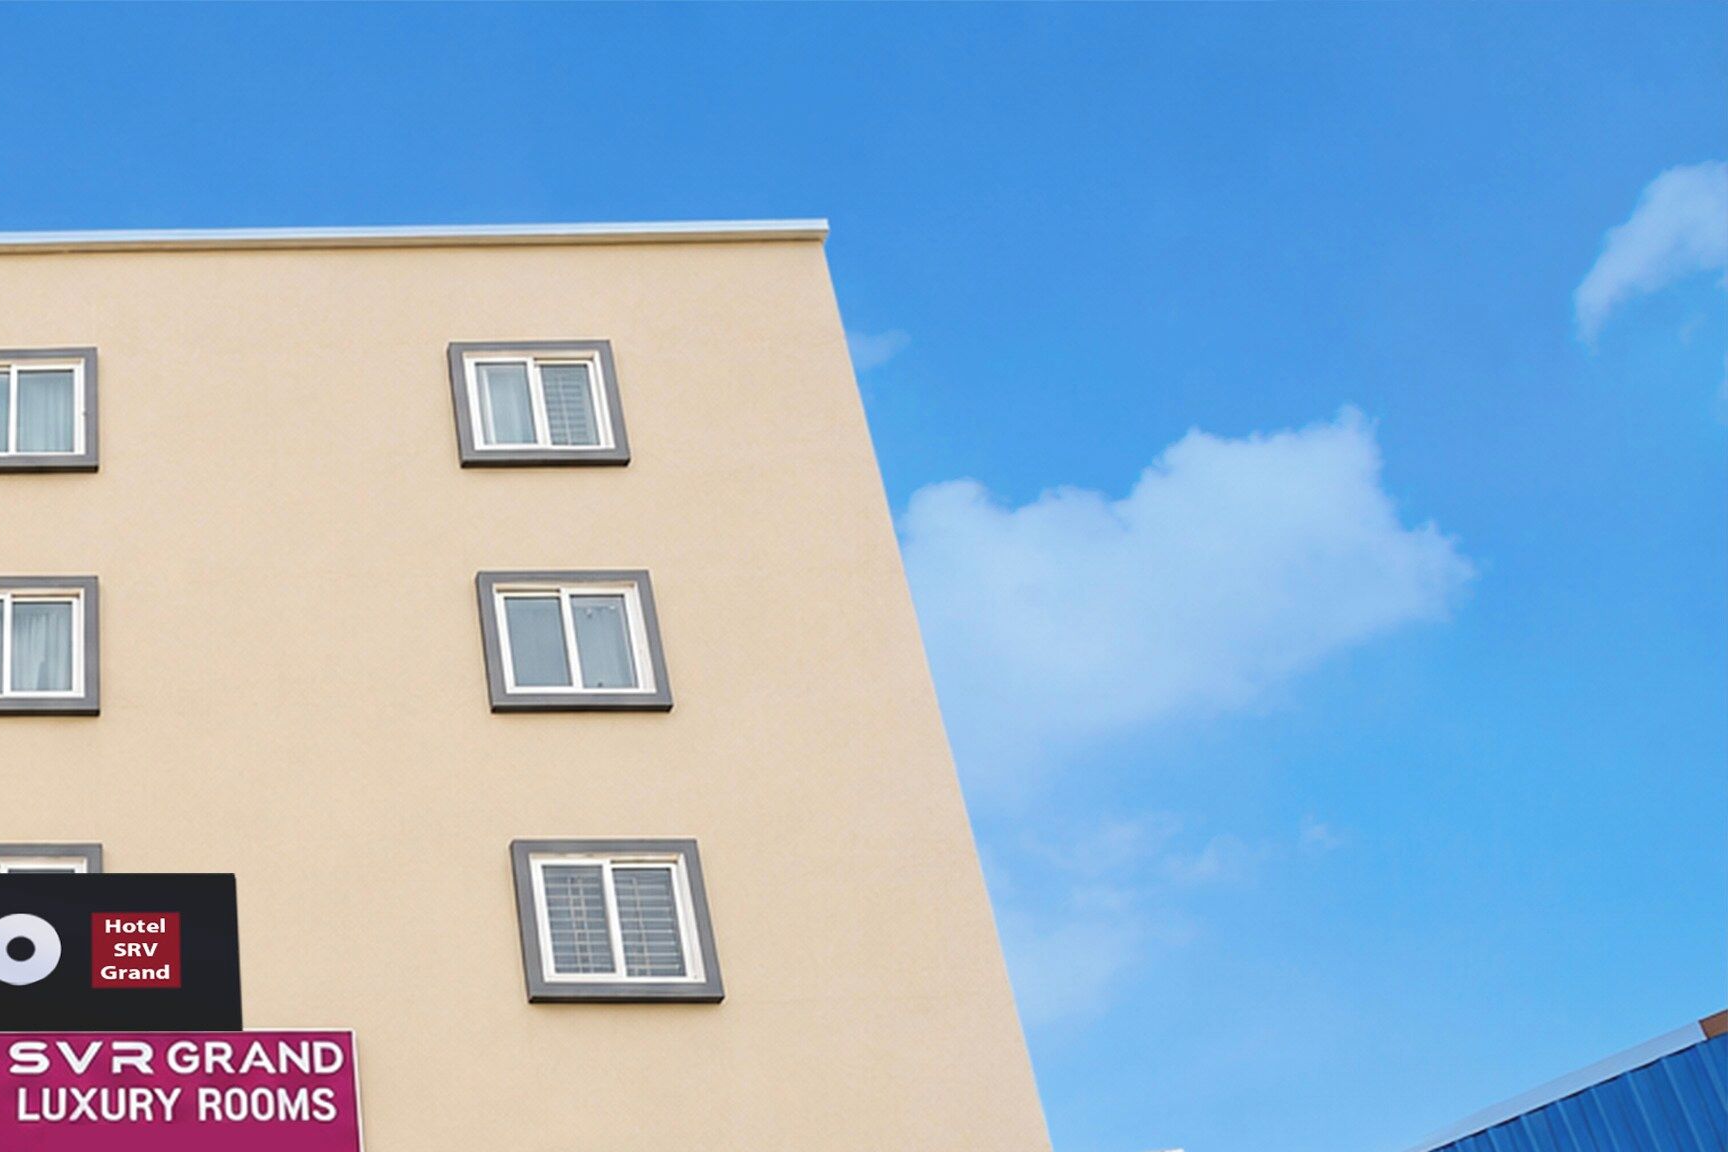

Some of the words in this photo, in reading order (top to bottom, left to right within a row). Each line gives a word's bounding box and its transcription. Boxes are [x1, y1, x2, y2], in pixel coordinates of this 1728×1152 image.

[104, 917, 166, 934] Hotel
[113, 942, 159, 958] SRV
[100, 964, 171, 980] Grand
[8, 1040, 154, 1075] SVR
[166, 1040, 345, 1075] GRAND
[17, 1086, 182, 1122] LUXURY
[198, 1086, 338, 1122] ROOMS
